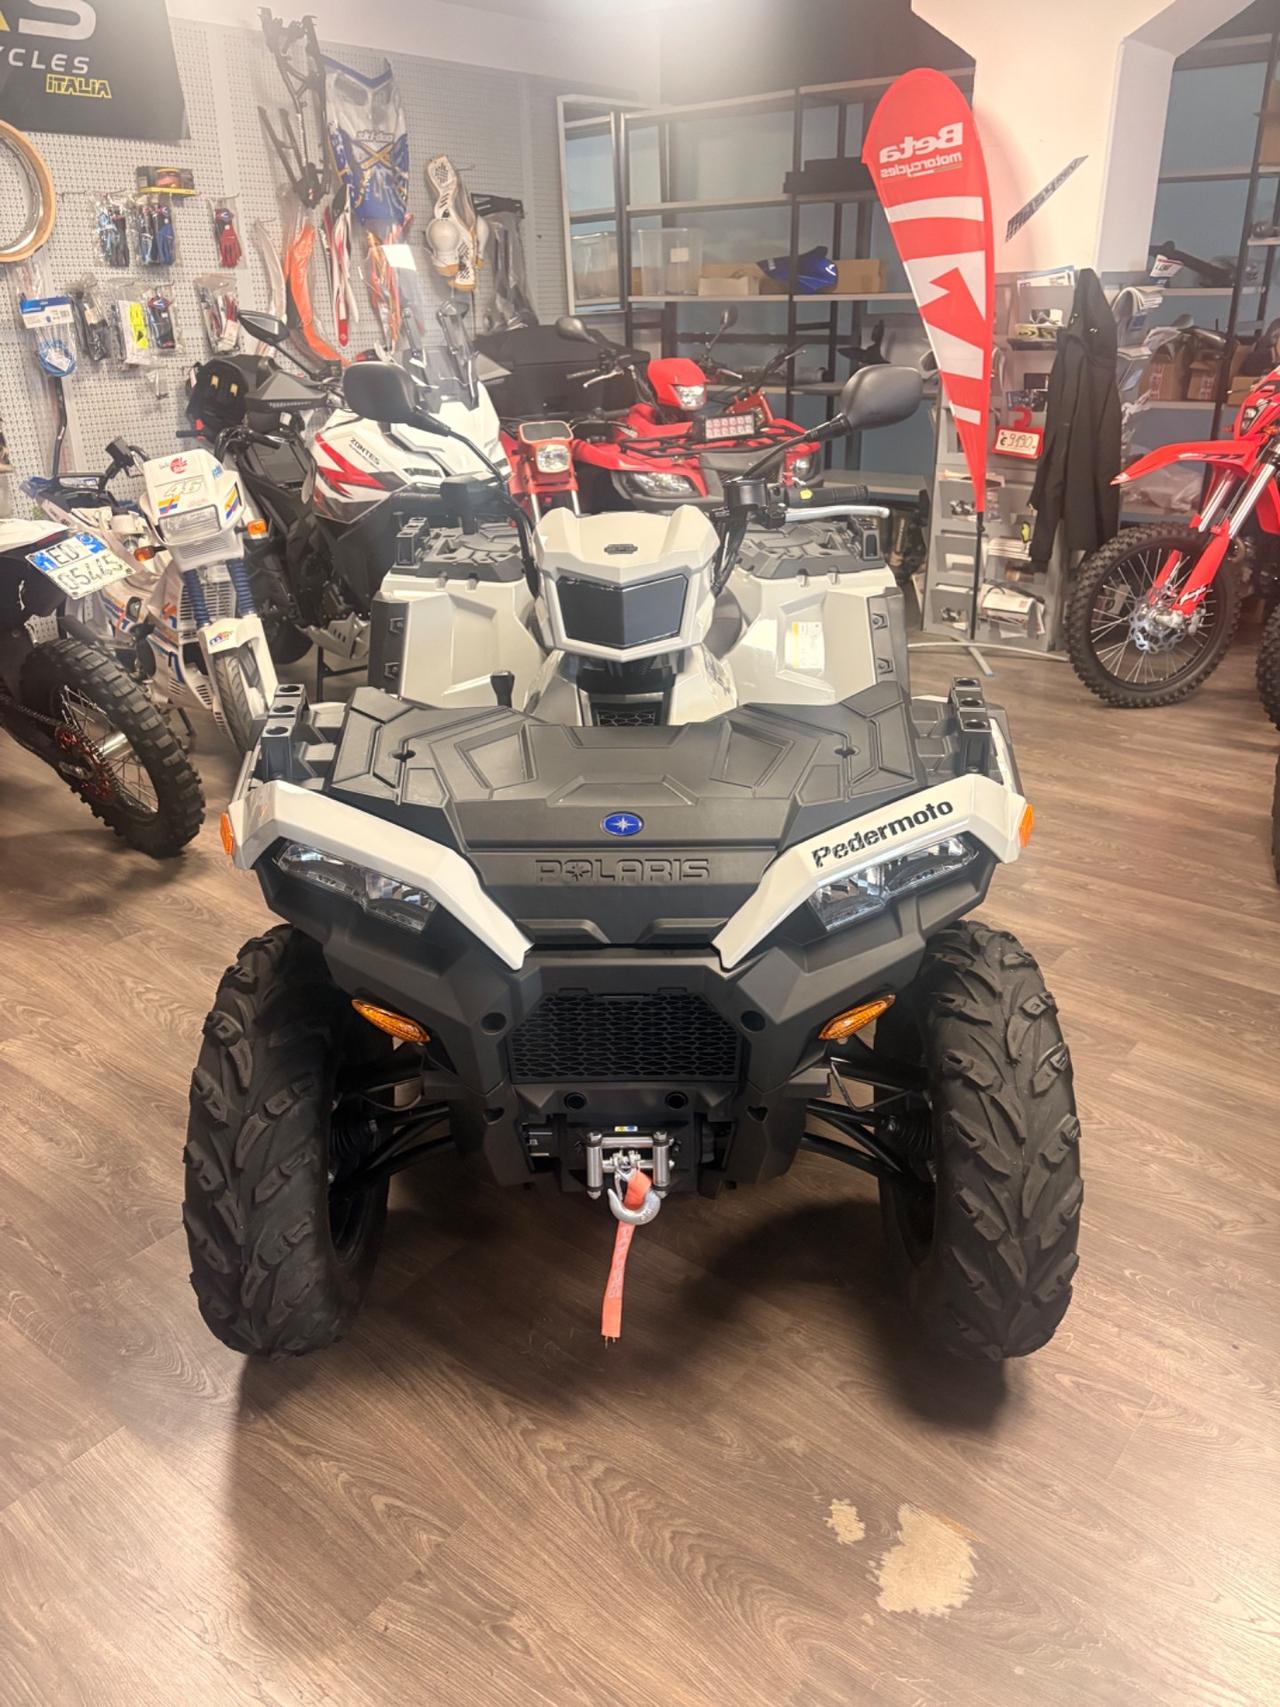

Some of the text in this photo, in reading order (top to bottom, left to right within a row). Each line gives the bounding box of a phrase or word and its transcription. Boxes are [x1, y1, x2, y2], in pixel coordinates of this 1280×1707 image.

[0, 46, 91, 74] CLES
[46, 543, 80, 565] ED
[811, 801, 954, 868] Pedermoto
[535, 858, 711, 884] POLARIS
